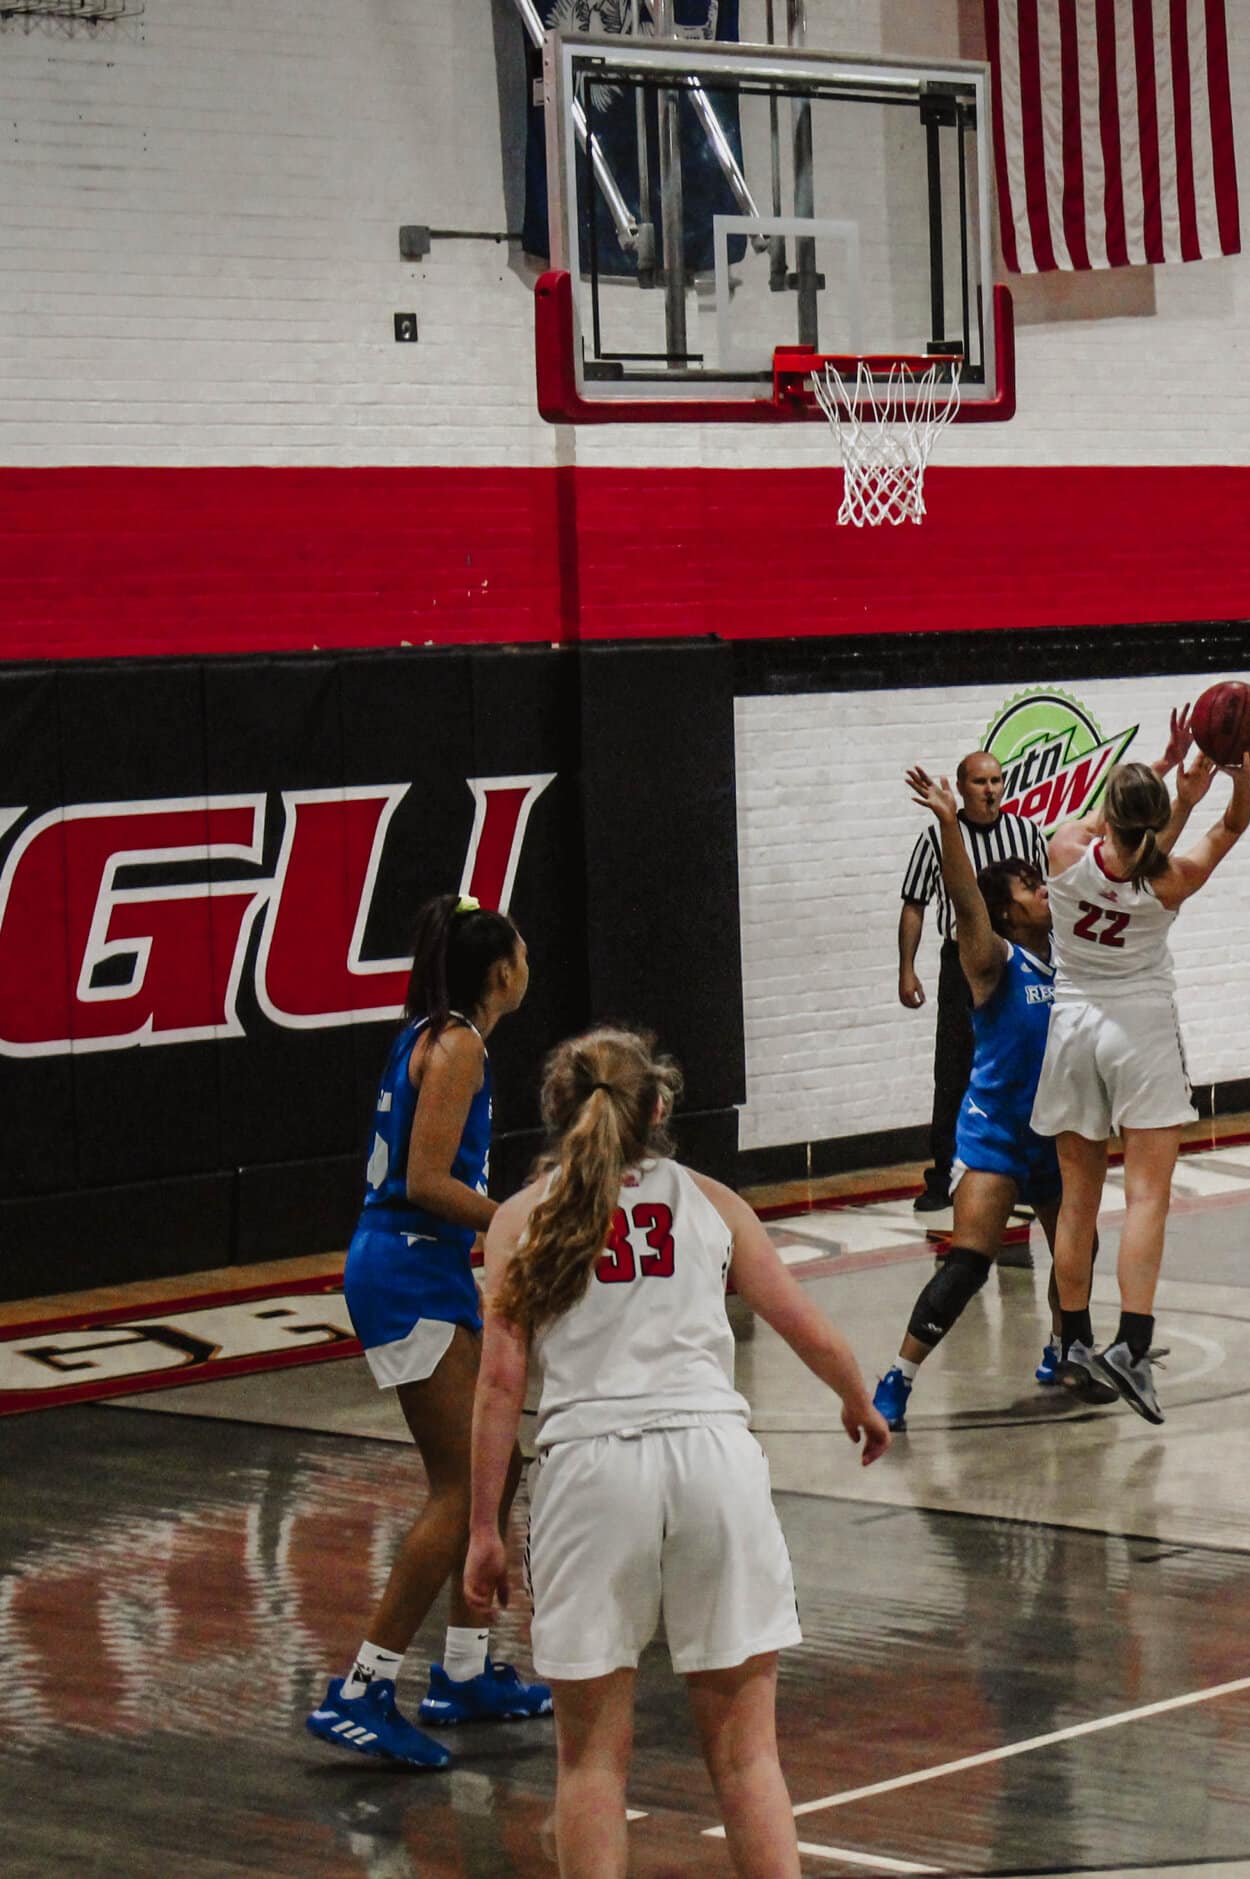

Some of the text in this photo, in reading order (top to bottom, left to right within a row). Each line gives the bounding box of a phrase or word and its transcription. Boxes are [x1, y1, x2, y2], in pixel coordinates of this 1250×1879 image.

[0, 772, 558, 1058] GU
[1073, 900, 1131, 948] 22
[595, 1203, 675, 1284] 33
